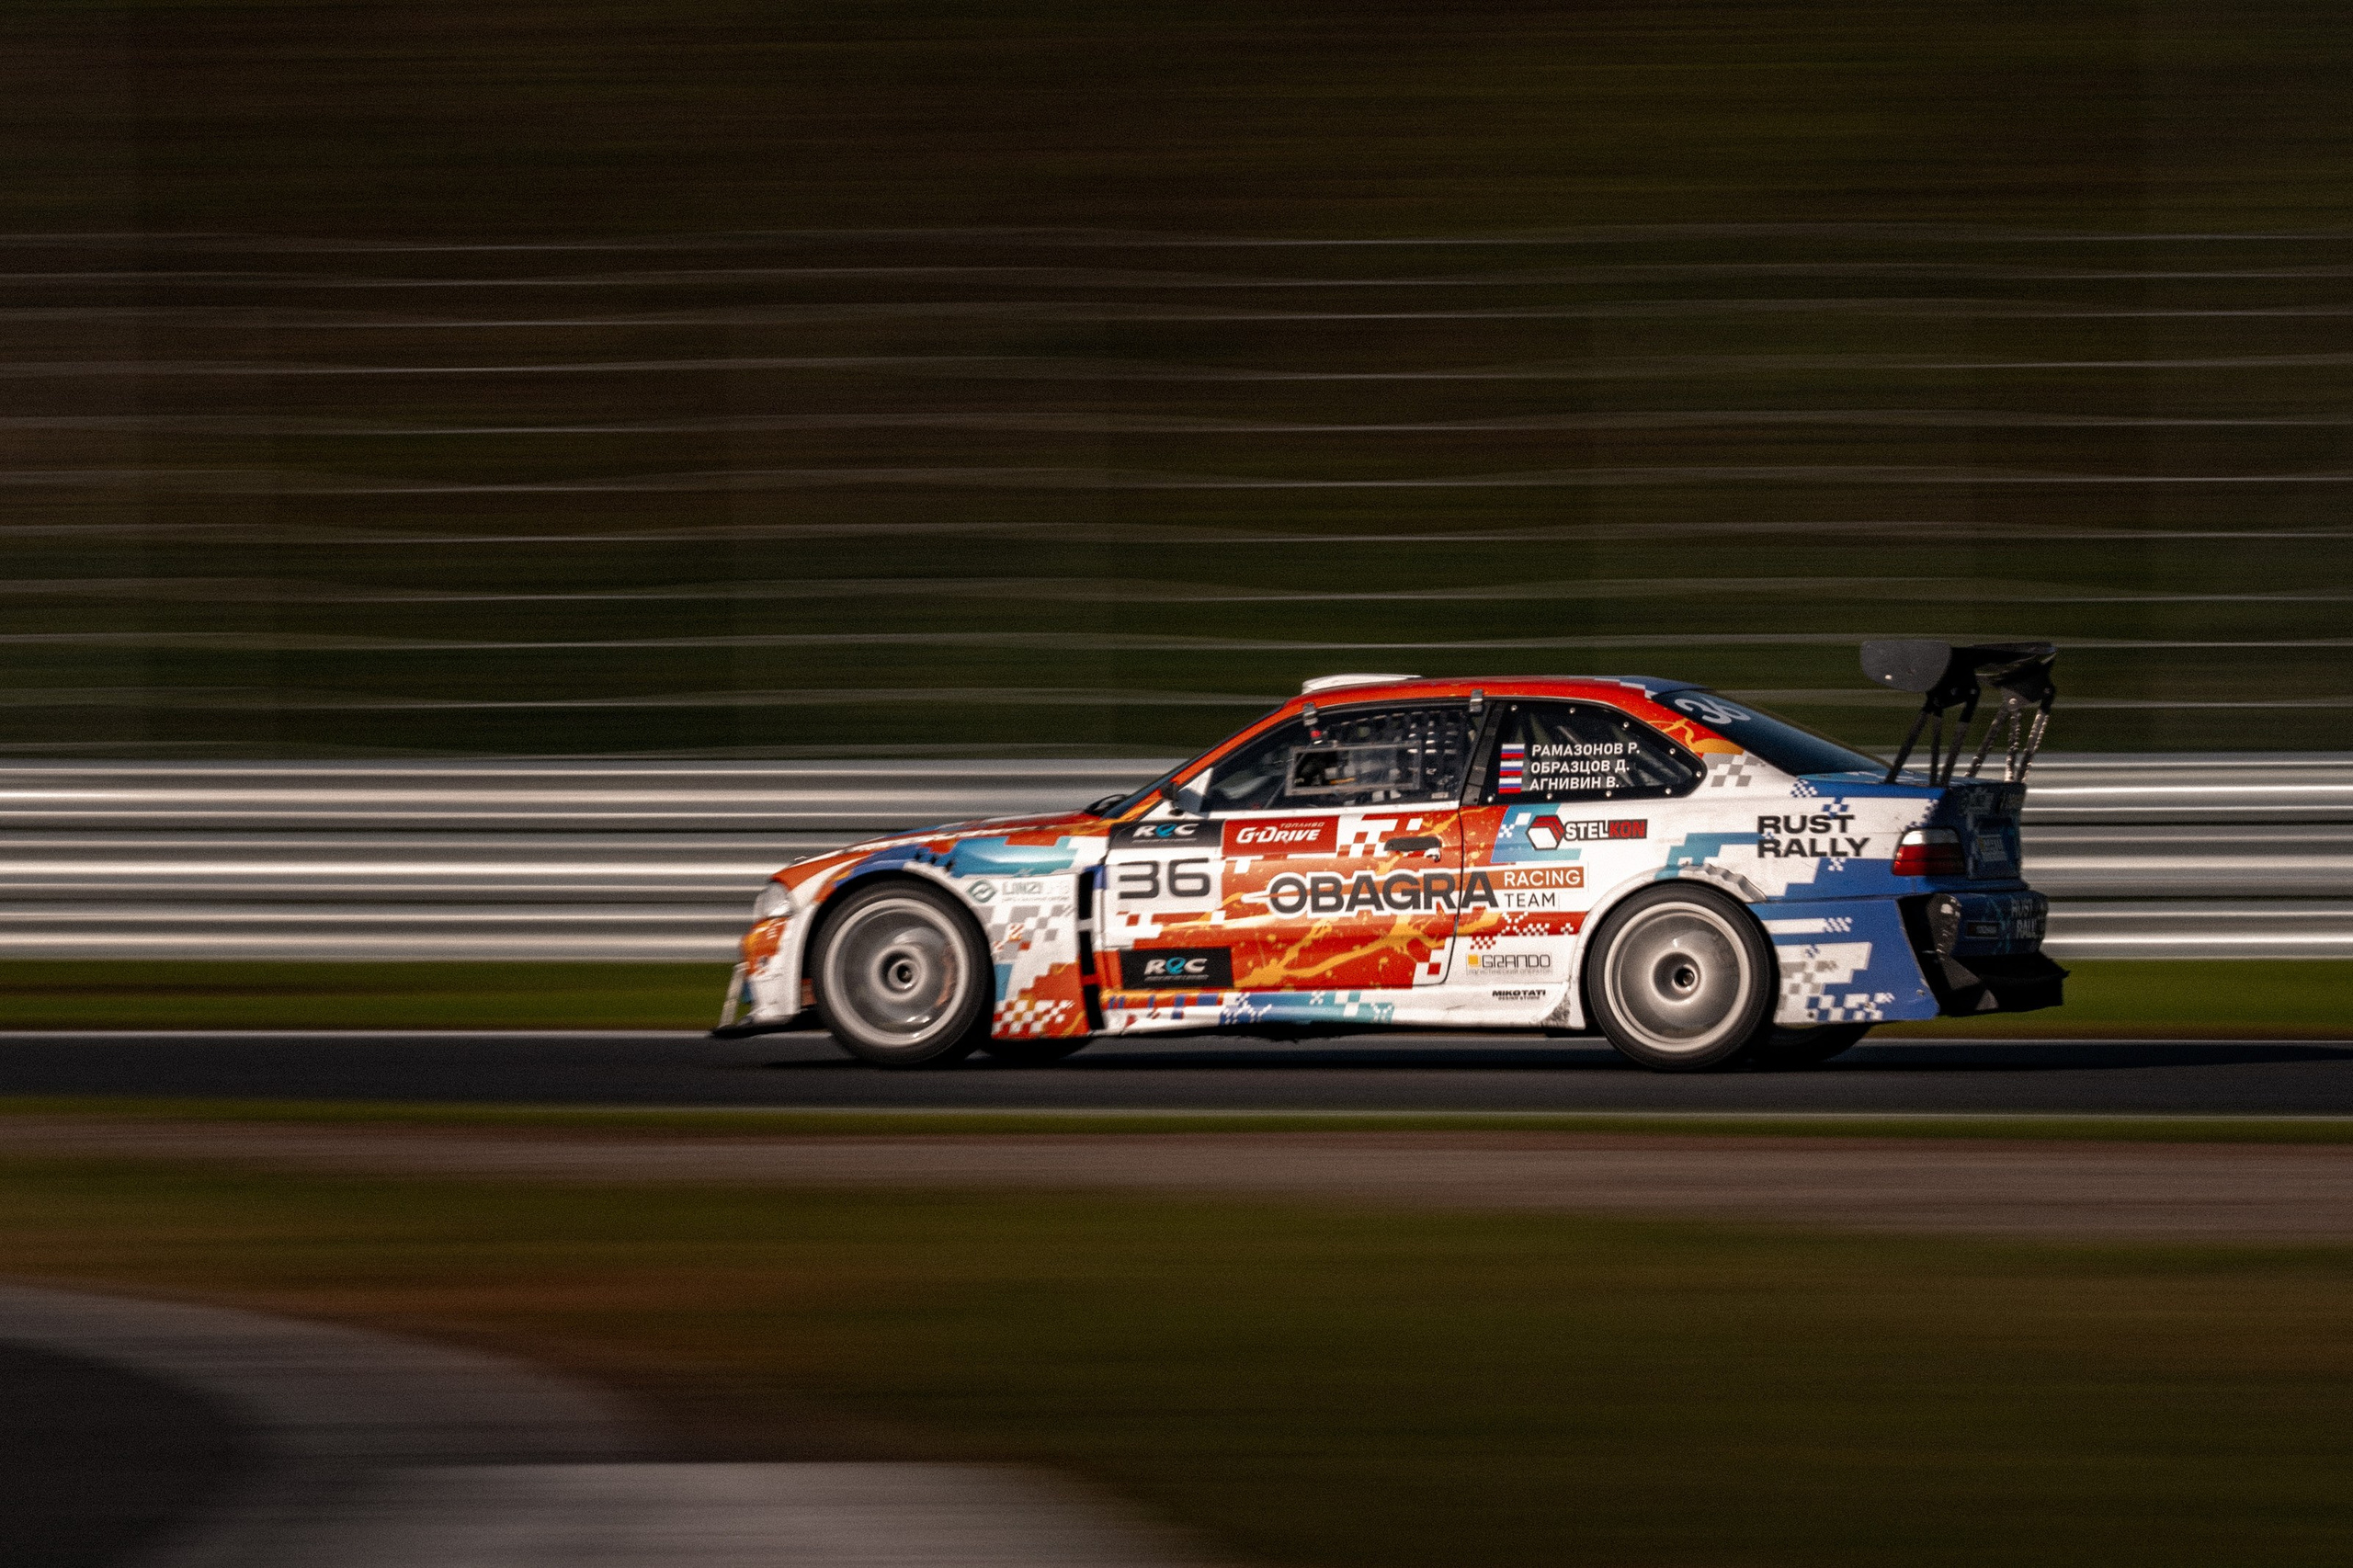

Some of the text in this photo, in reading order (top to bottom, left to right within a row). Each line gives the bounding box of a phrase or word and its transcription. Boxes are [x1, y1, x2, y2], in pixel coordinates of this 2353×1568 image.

[1675, 697, 1751, 724] 36
[1531, 742, 1641, 757] РАМАЗОНОВ Р.
[1530, 759, 1631, 775] ОБРАЗЦОВ Д.
[1529, 776, 1620, 791] АГНИВИН В.
[1564, 819, 1647, 841] STELKON
[1757, 814, 1856, 835] RUST
[1757, 837, 1871, 858] RALLY
[1118, 858, 1211, 900] 36
[1504, 869, 1581, 887] RACING
[1269, 870, 1500, 914] OBAGRA
[1504, 892, 1555, 907] TEAM
